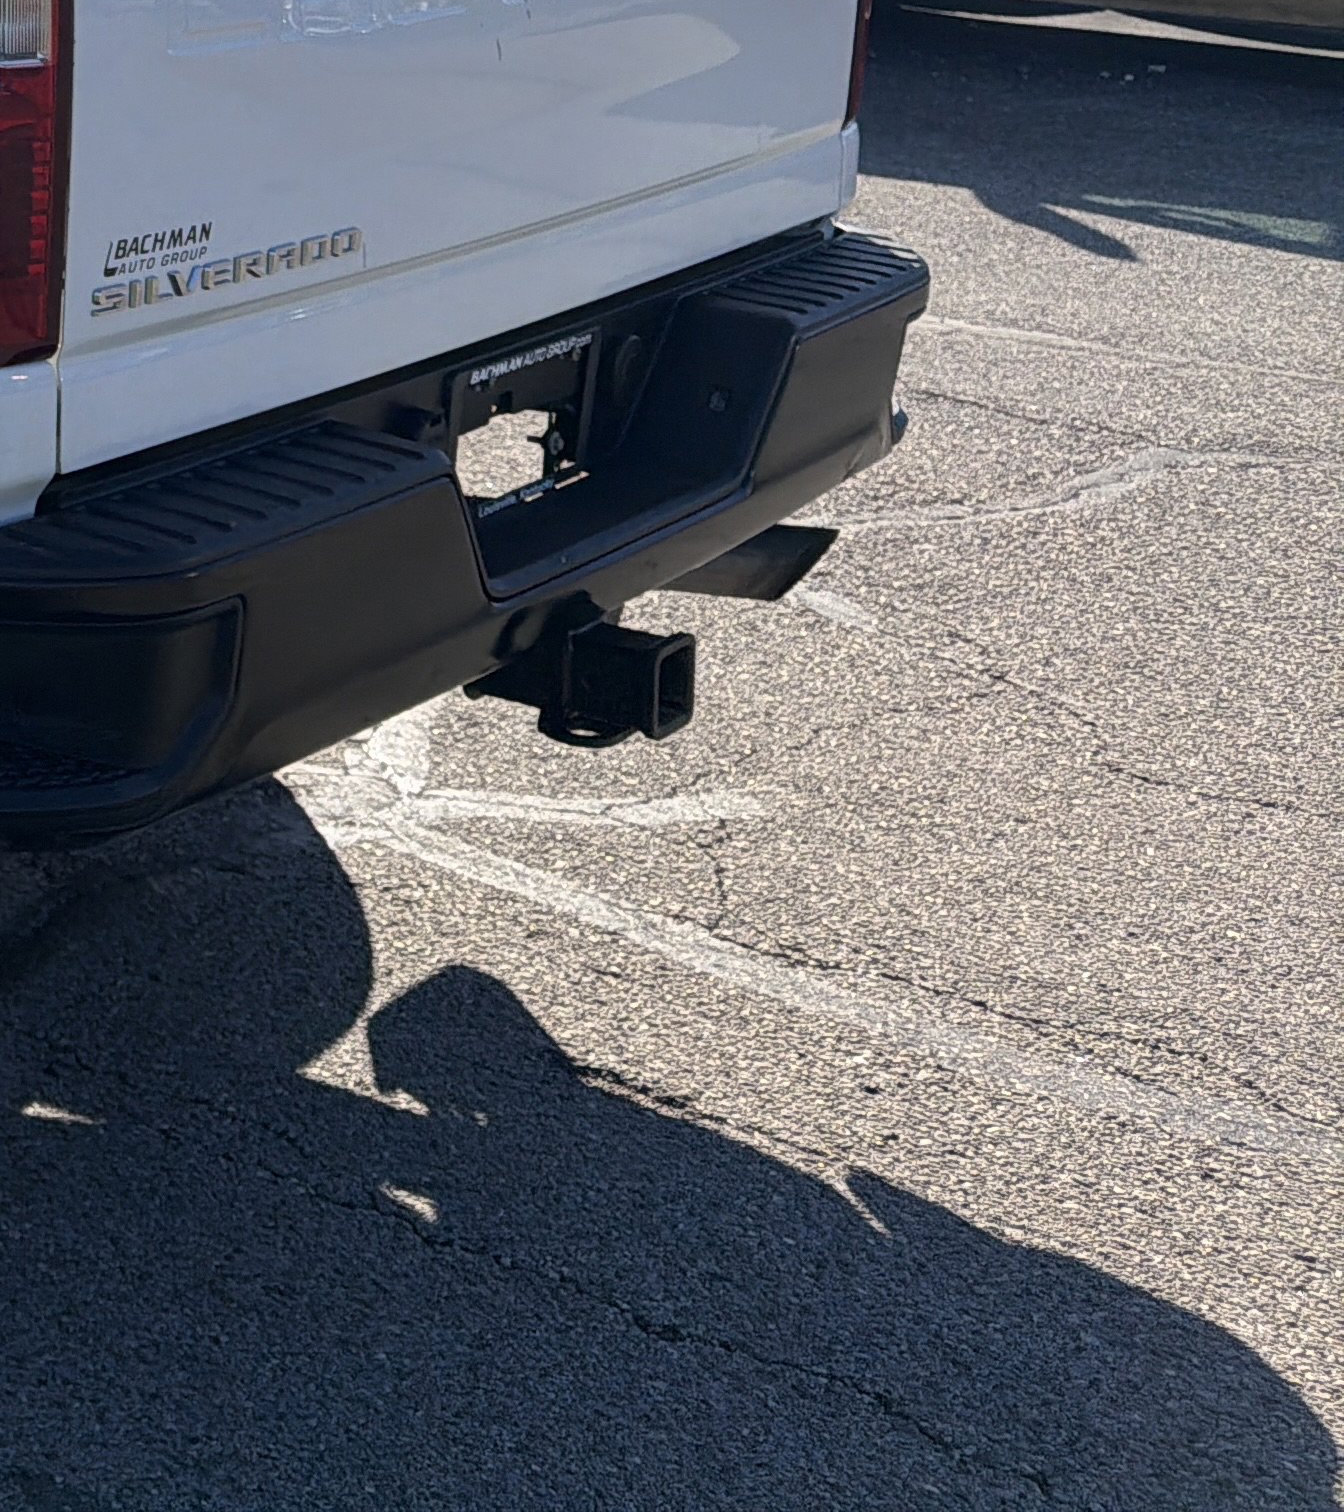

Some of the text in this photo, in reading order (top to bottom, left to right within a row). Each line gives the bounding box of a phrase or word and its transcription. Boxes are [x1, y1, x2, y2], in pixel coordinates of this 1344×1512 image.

[114, 222, 213, 260] BACHMAN
[90, 226, 364, 318] SILVERADO
[118, 245, 208, 276] AUTO GROUP
